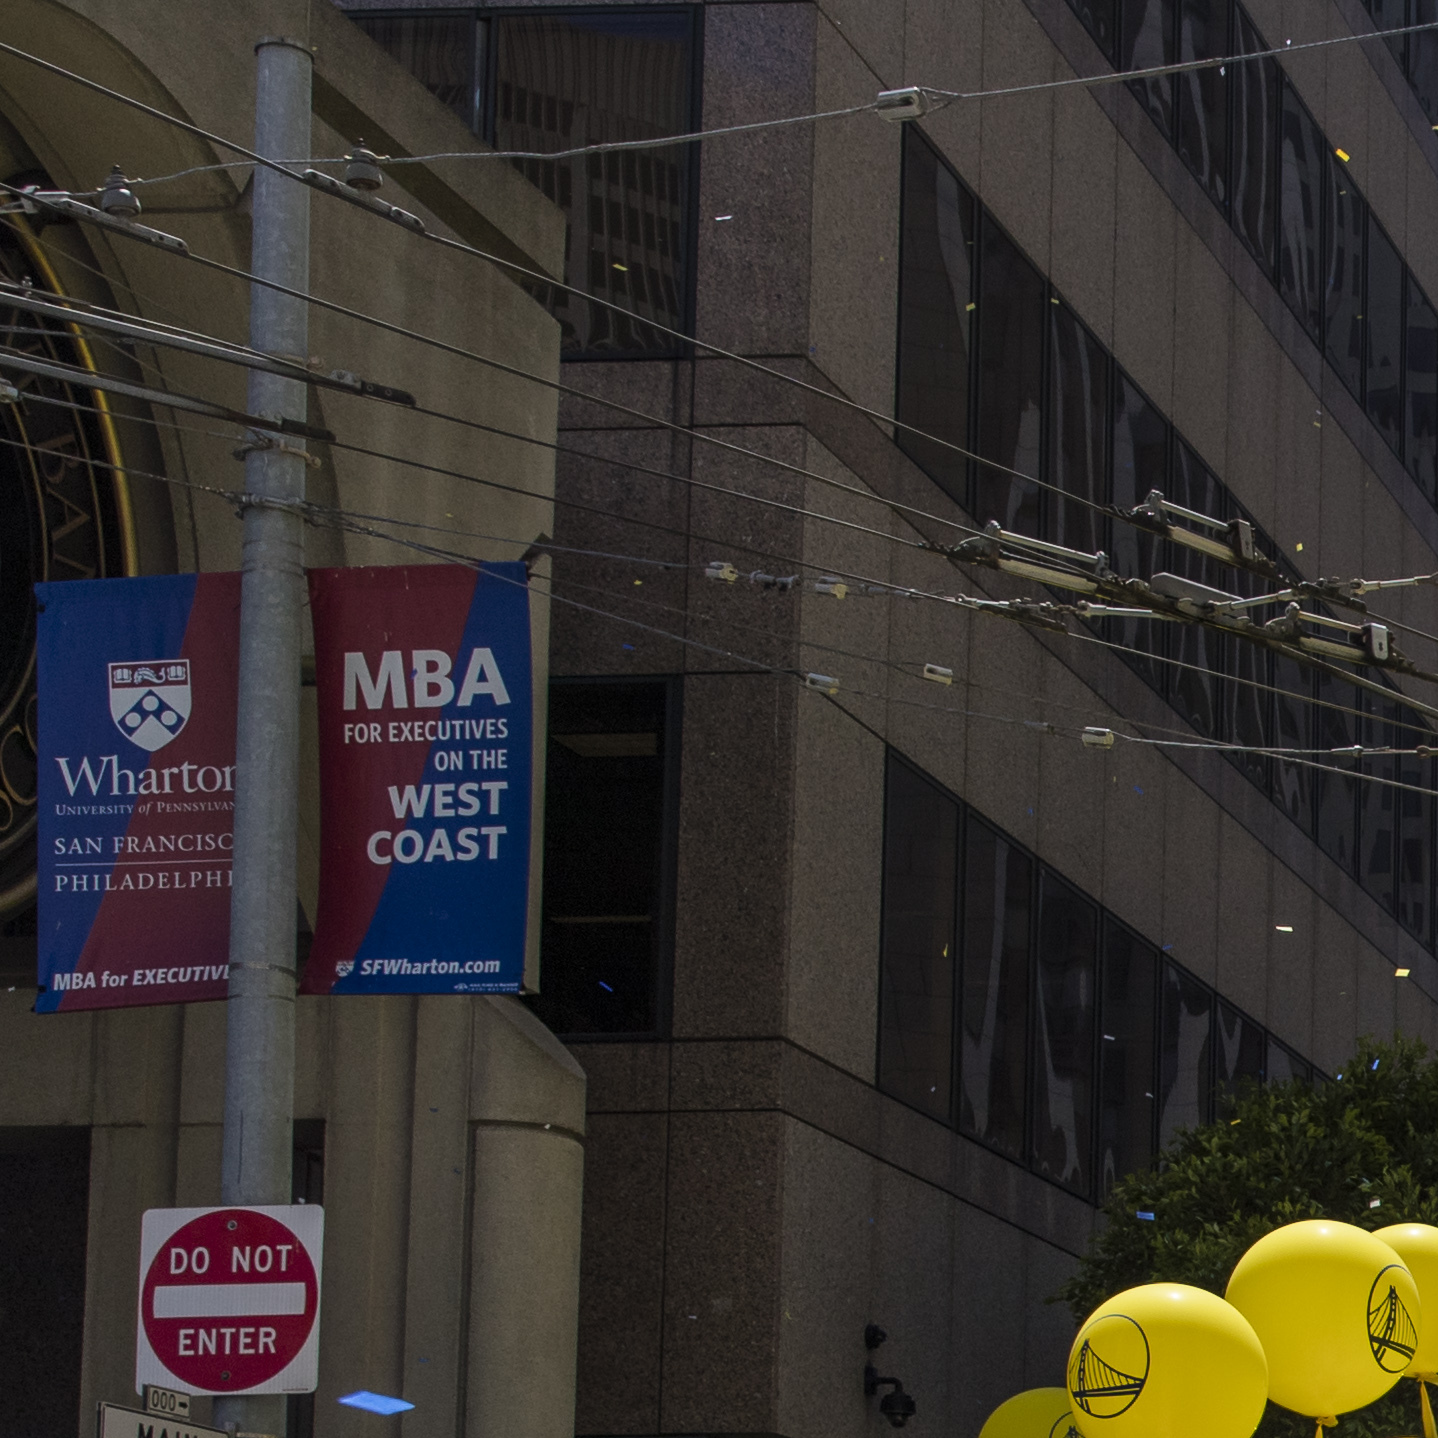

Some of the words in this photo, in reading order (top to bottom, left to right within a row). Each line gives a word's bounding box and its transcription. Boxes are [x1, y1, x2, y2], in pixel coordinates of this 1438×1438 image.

[343, 647, 511, 711] MBA
[344, 722, 383, 744] FOR
[388, 718, 509, 742] EXECUTIVES
[434, 750, 463, 772] ON
[469, 749, 508, 770] THE
[138, 801, 153, 816] of
[387, 781, 509, 819] WEST
[54, 836, 103, 855] SAN
[112, 832, 234, 854] FRANCISC
[366, 825, 508, 865] COAST
[54, 869, 233, 892] PHILADELPHI
[53, 971, 97, 991] MBA
[101, 970, 129, 989] for
[132, 964, 231, 986] EXECUTIV
[359, 958, 501, 976] SFWharton.com
[169, 1246, 210, 1275] DO
[231, 1244, 293, 1273] NOT
[178, 1326, 277, 1357] ENTER
[151, 1389, 176, 1412] 000
